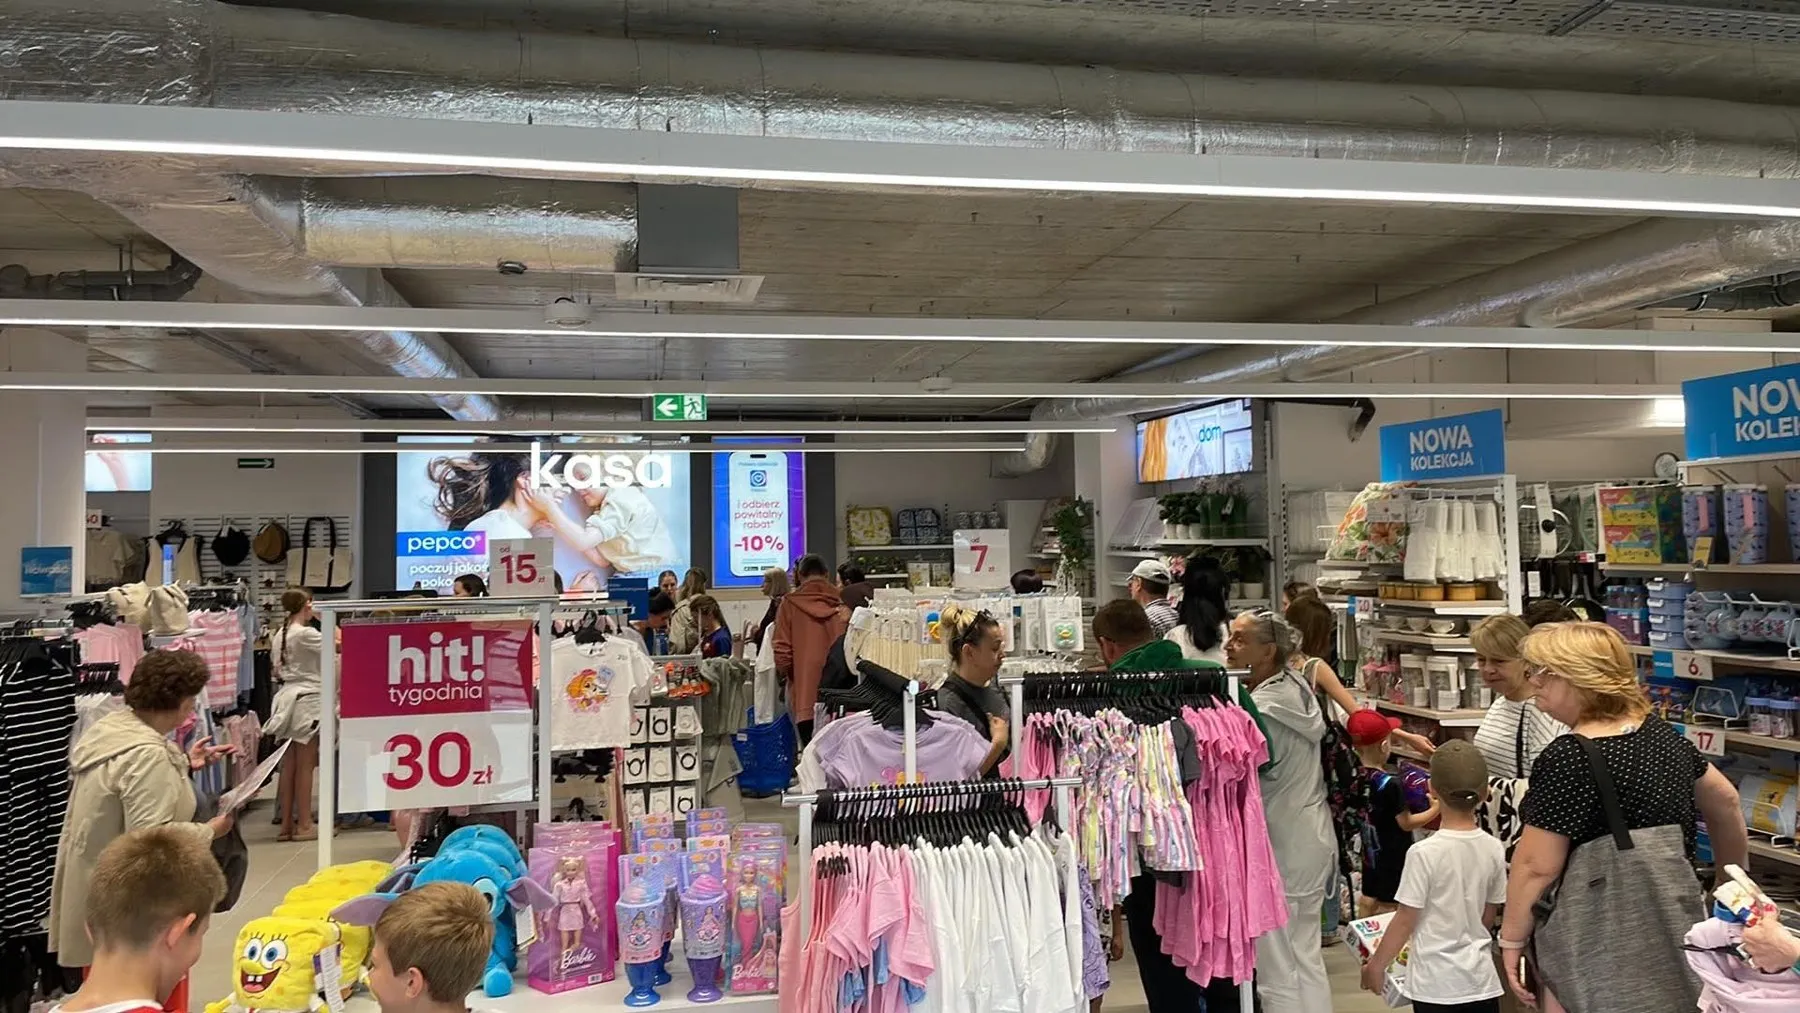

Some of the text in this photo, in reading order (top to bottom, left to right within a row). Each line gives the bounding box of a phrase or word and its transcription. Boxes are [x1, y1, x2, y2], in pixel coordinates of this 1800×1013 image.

[1199, 425, 1220, 443] dom
[1409, 424, 1474, 454] NOWA
[530, 441, 672, 490] kasa
[1410, 451, 1474, 472] KOLEKCJA
[742, 498, 780, 509] odbierz
[734, 509, 784, 521] powitalny
[407, 534, 476, 553] pepco
[734, 535, 785, 552] -10%
[409, 561, 489, 575] poczuj jakoś
[500, 553, 538, 584] 15
[970, 545, 989, 573] 7
[388, 631, 485, 685] hit!
[1688, 657, 1699, 676] 6
[388, 683, 483, 706] tygodnia
[1697, 731, 1714, 751] 17
[382, 731, 493, 790] 30 zł
[560, 947, 597, 969] Barbie
